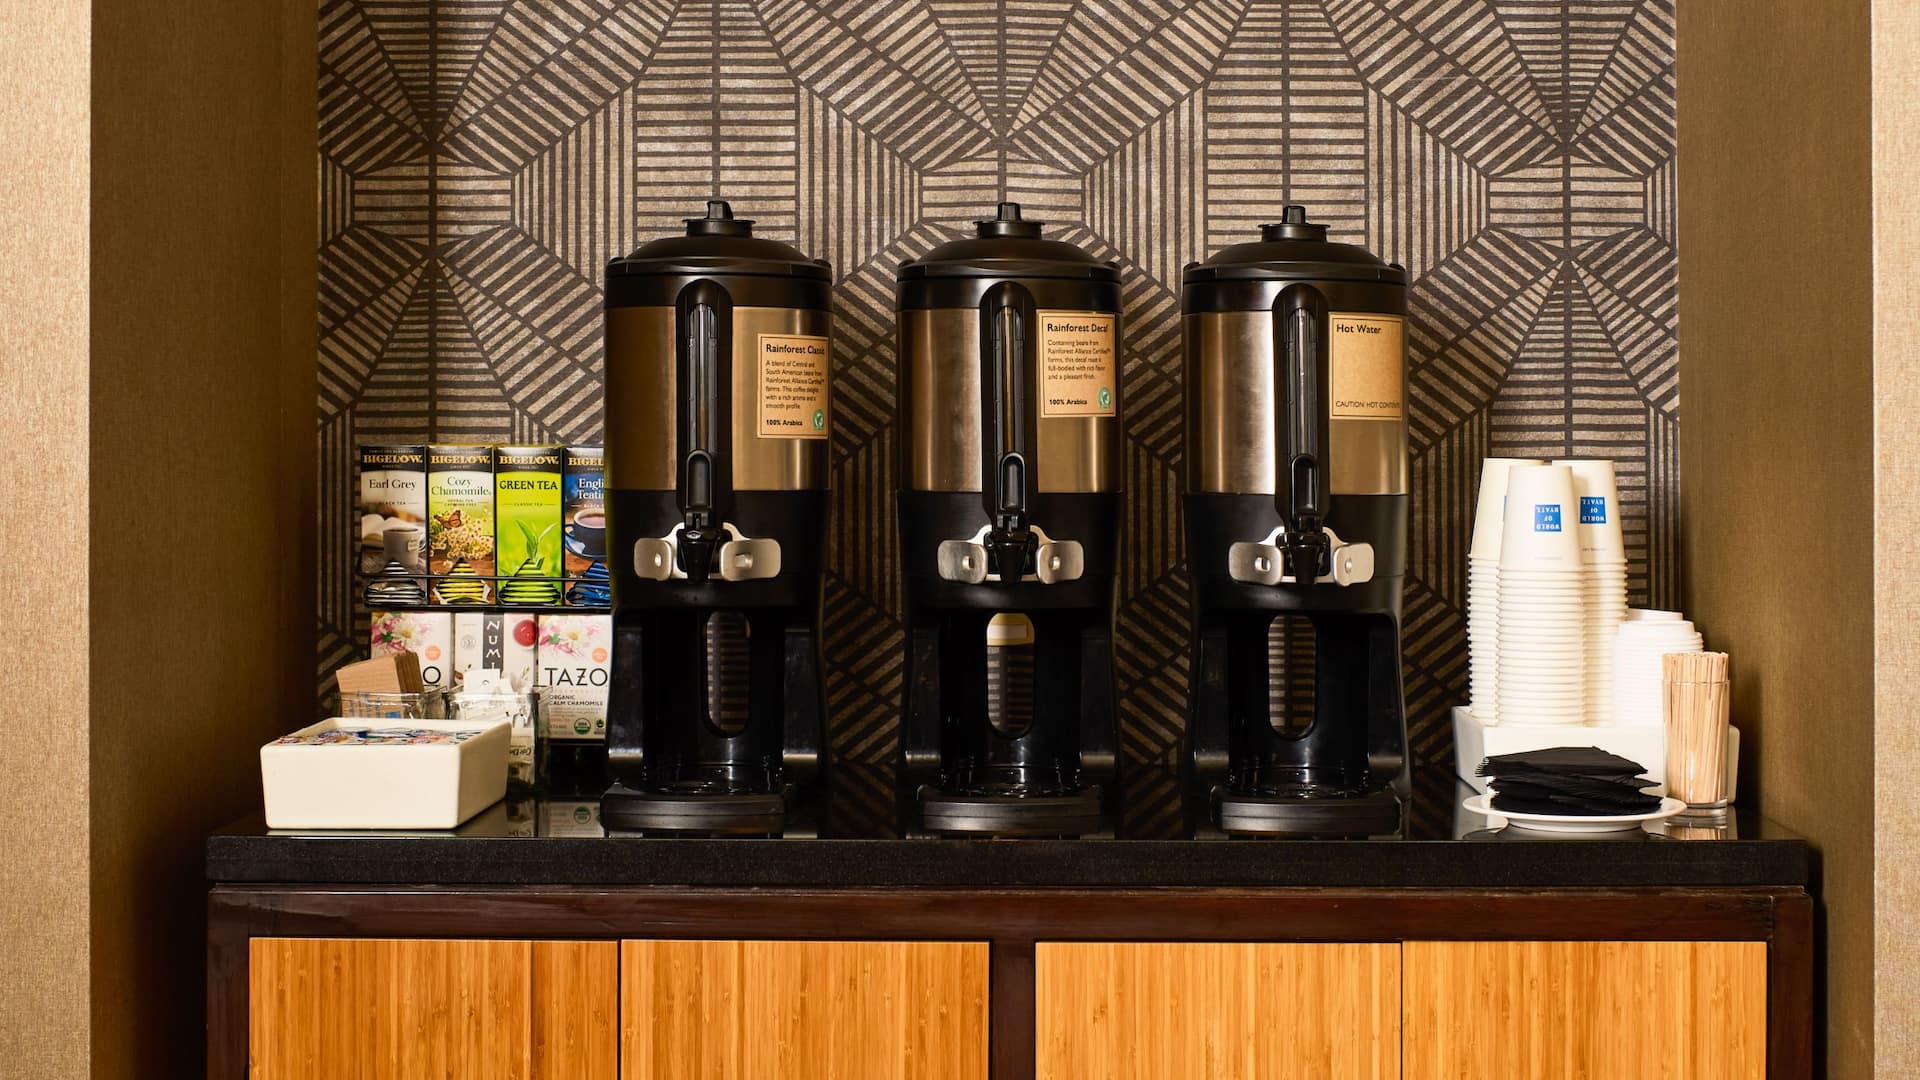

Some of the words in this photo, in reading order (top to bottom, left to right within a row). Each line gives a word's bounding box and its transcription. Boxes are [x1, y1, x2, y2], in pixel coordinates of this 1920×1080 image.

[1047, 324, 1090, 332] Rainforest
[1336, 324, 1354, 333] Hot
[1357, 324, 1382, 334] Water
[766, 344, 806, 354] Rainforest
[568, 457, 604, 466] BIGEL
[369, 479, 389, 489] Earl
[392, 479, 416, 491] Grey
[447, 476, 472, 488] Cozy
[499, 480, 535, 490] GREEN
[537, 480, 558, 490] TEA
[578, 479, 604, 491] Engli
[431, 486, 489, 496] Chamomile
[577, 490, 604, 499] Teati
[544, 668, 608, 686] TAZO
